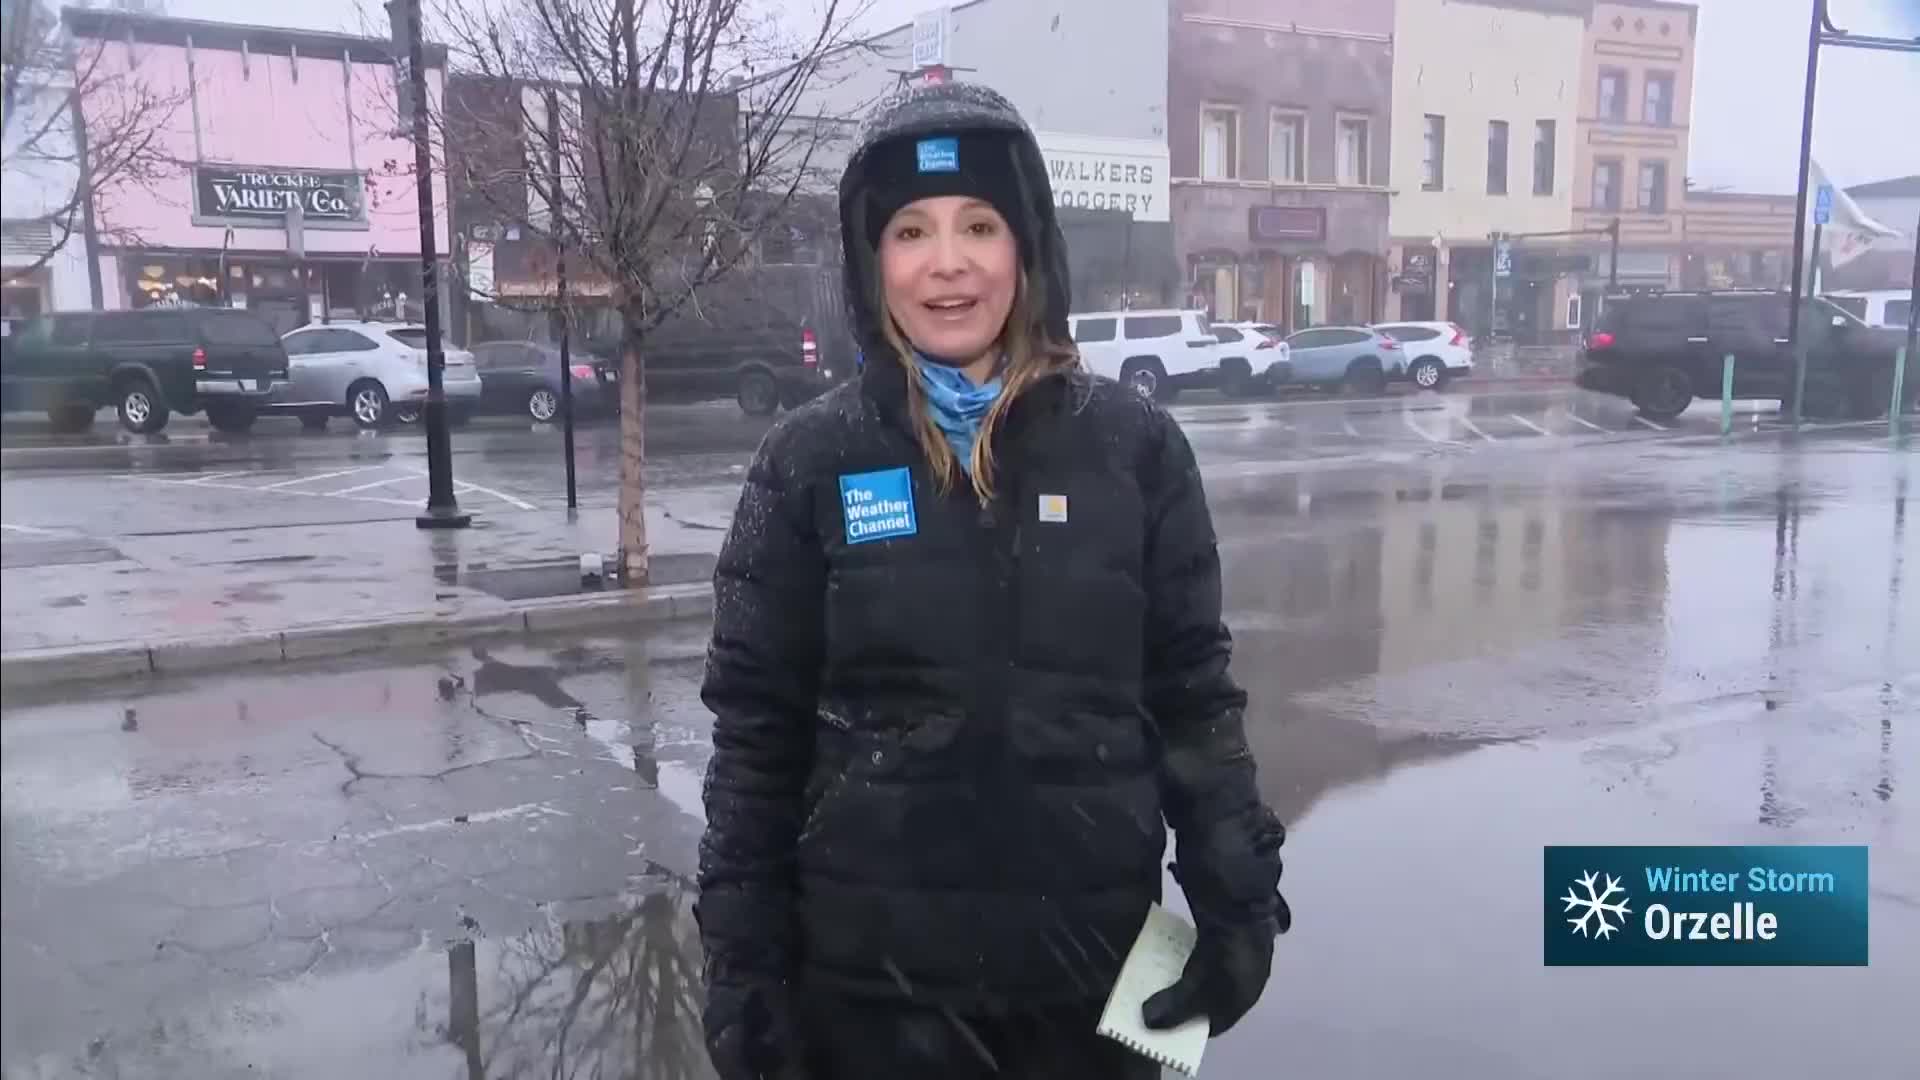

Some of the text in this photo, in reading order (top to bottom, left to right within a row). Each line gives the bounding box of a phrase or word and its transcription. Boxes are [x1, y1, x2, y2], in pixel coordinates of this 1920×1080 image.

[236, 172, 321, 188] TRUCKEE
[1050, 159, 1153, 184] WALKERS
[845, 487, 873, 505] The
[847, 499, 909, 521] Weather
[849, 512, 910, 537] Channel
